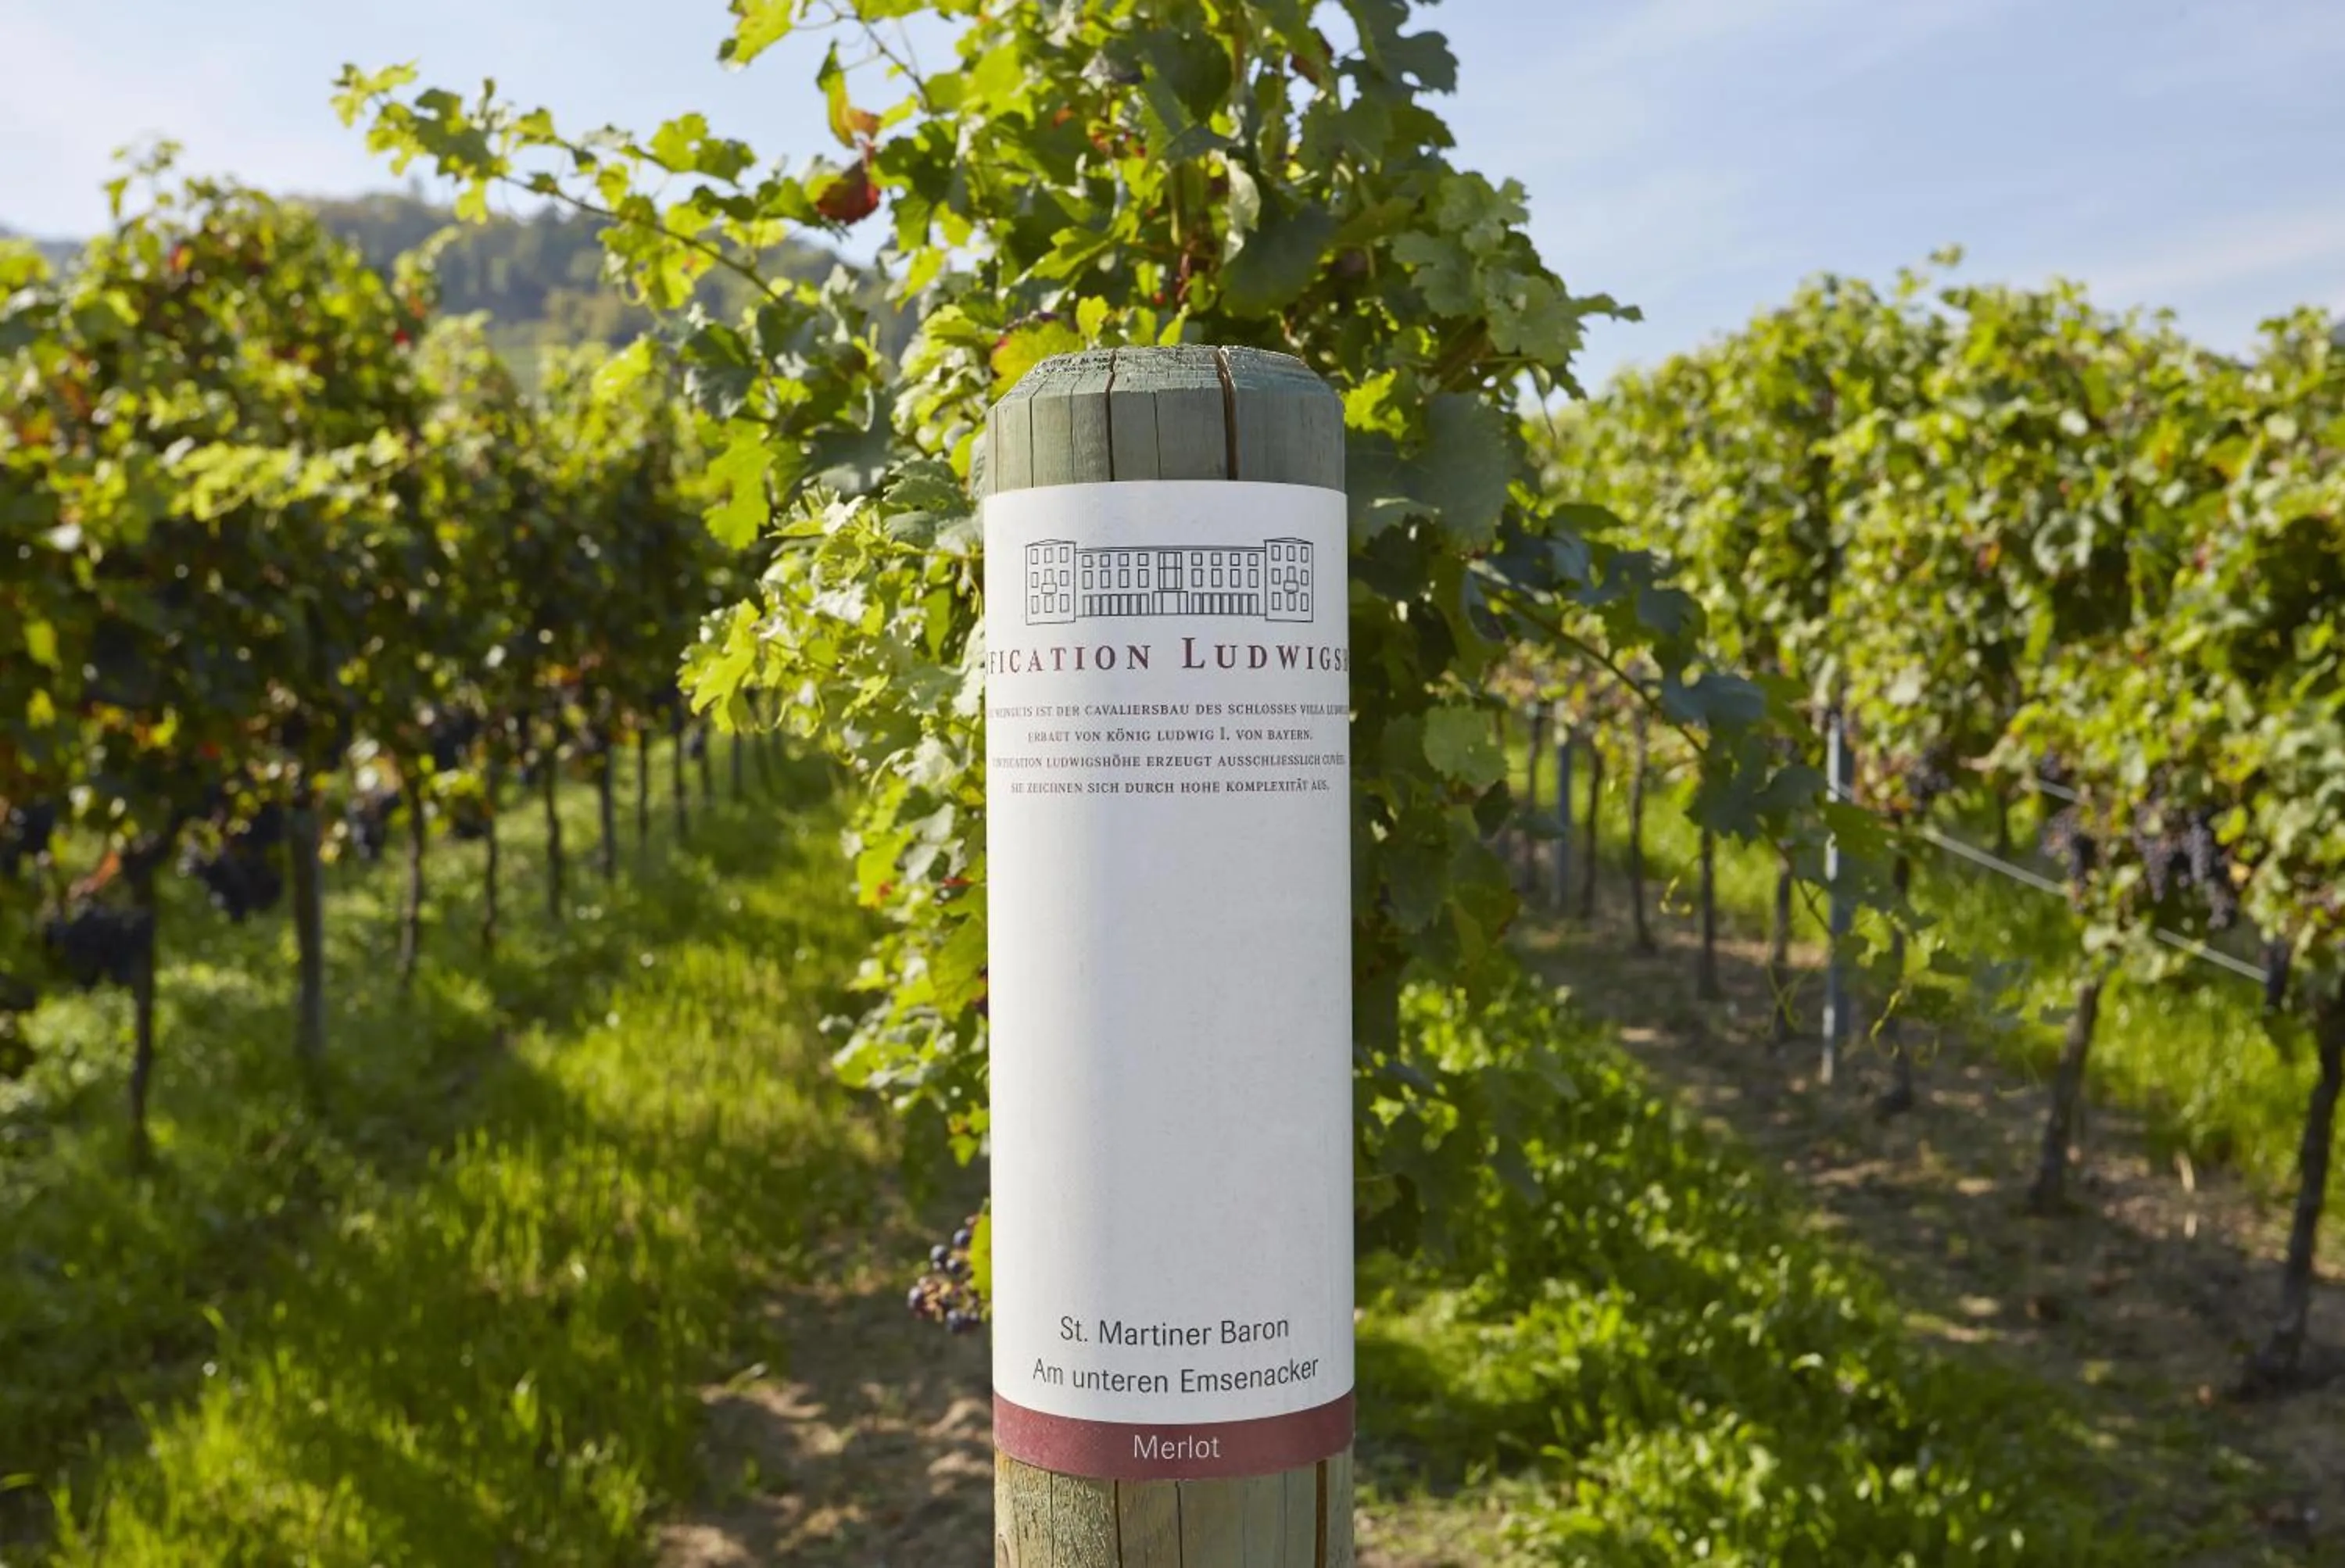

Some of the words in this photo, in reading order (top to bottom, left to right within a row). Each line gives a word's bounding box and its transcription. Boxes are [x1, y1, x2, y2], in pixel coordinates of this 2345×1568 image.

[986, 645, 1151, 675] FICATION
[1036, 706, 1053, 717] IST
[1056, 705, 1080, 717] DER
[1084, 703, 1190, 717] CAVALIERSBAU
[1195, 703, 1223, 716] DES
[1227, 703, 1297, 715] SCHLOSSES
[1027, 730, 1070, 743] ERBAUT
[1074, 730, 1101, 743] VON
[1106, 728, 1151, 743] KÖNIG
[1157, 729, 1215, 743] LUDWIG
[1235, 729, 1263, 741] VON
[1267, 729, 1313, 741] BAYERN.
[1046, 754, 1141, 768] LUDWIGSHÖHE
[1146, 755, 1212, 768] ERZEUGT
[1217, 754, 1321, 768] AUSSCHLIESSLICH
[1026, 782, 1083, 794] ZEICHNEN
[1087, 782, 1120, 794] SICH
[1124, 781, 1175, 794] DURCH
[1180, 780, 1220, 794] HOHE
[1226, 779, 1309, 793] KOMPLEXITÄT
[1059, 1315, 1089, 1343] St.
[1098, 1319, 1212, 1348] Martiner
[1221, 1319, 1289, 1344] Baron
[1032, 1357, 1064, 1386] Am
[1072, 1369, 1169, 1394] unteren
[1181, 1357, 1319, 1394] Emsenacker
[1134, 1434, 1219, 1459] Merlot
